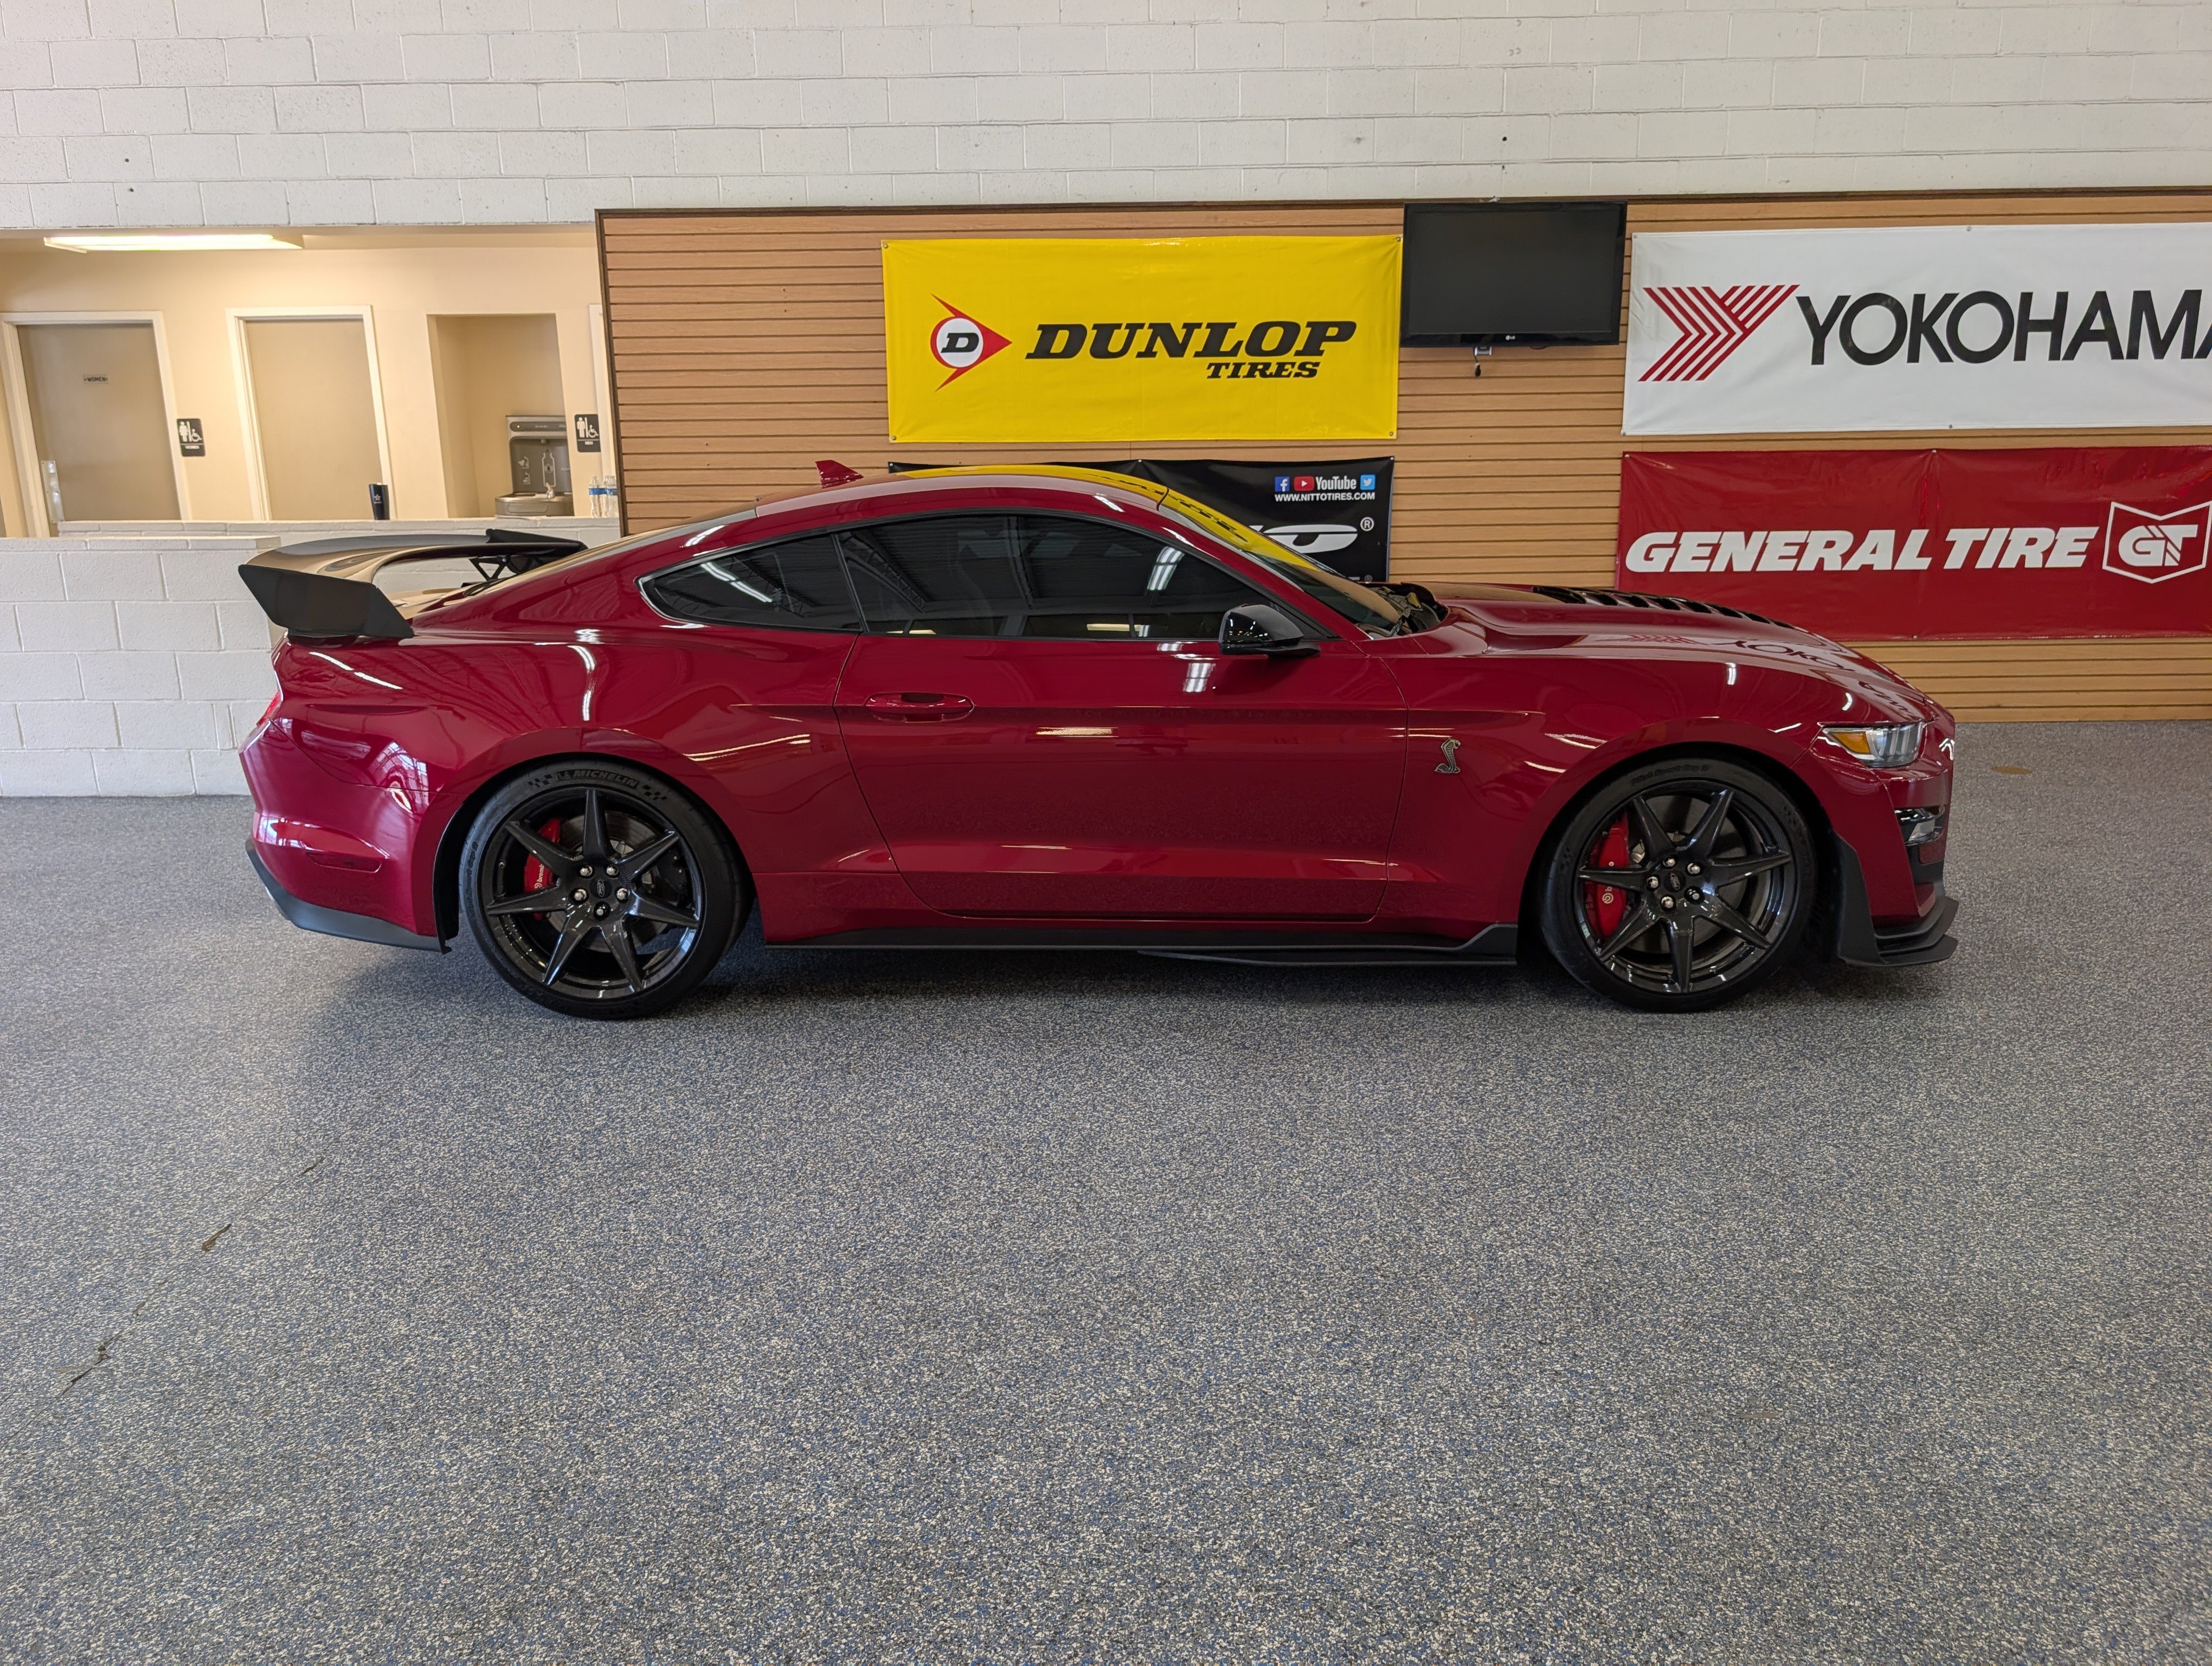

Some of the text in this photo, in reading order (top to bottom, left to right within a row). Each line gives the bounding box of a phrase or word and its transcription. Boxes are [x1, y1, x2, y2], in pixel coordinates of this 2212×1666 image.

[1796, 289, 2212, 365] YOKOHAM
[941, 332, 977, 354] D
[1025, 321, 1357, 360] DUNLOP
[1207, 361, 1321, 379] TIRES
[1315, 476, 1357, 490] YouTube
[1274, 492, 1375, 502] WWW.NITTOTIRES.COM
[1625, 527, 2099, 573] GENERAL TIRE
[2118, 524, 2199, 567] GT
[573, 770, 638, 787] MICHELIN
[536, 863, 545, 883] bremb
